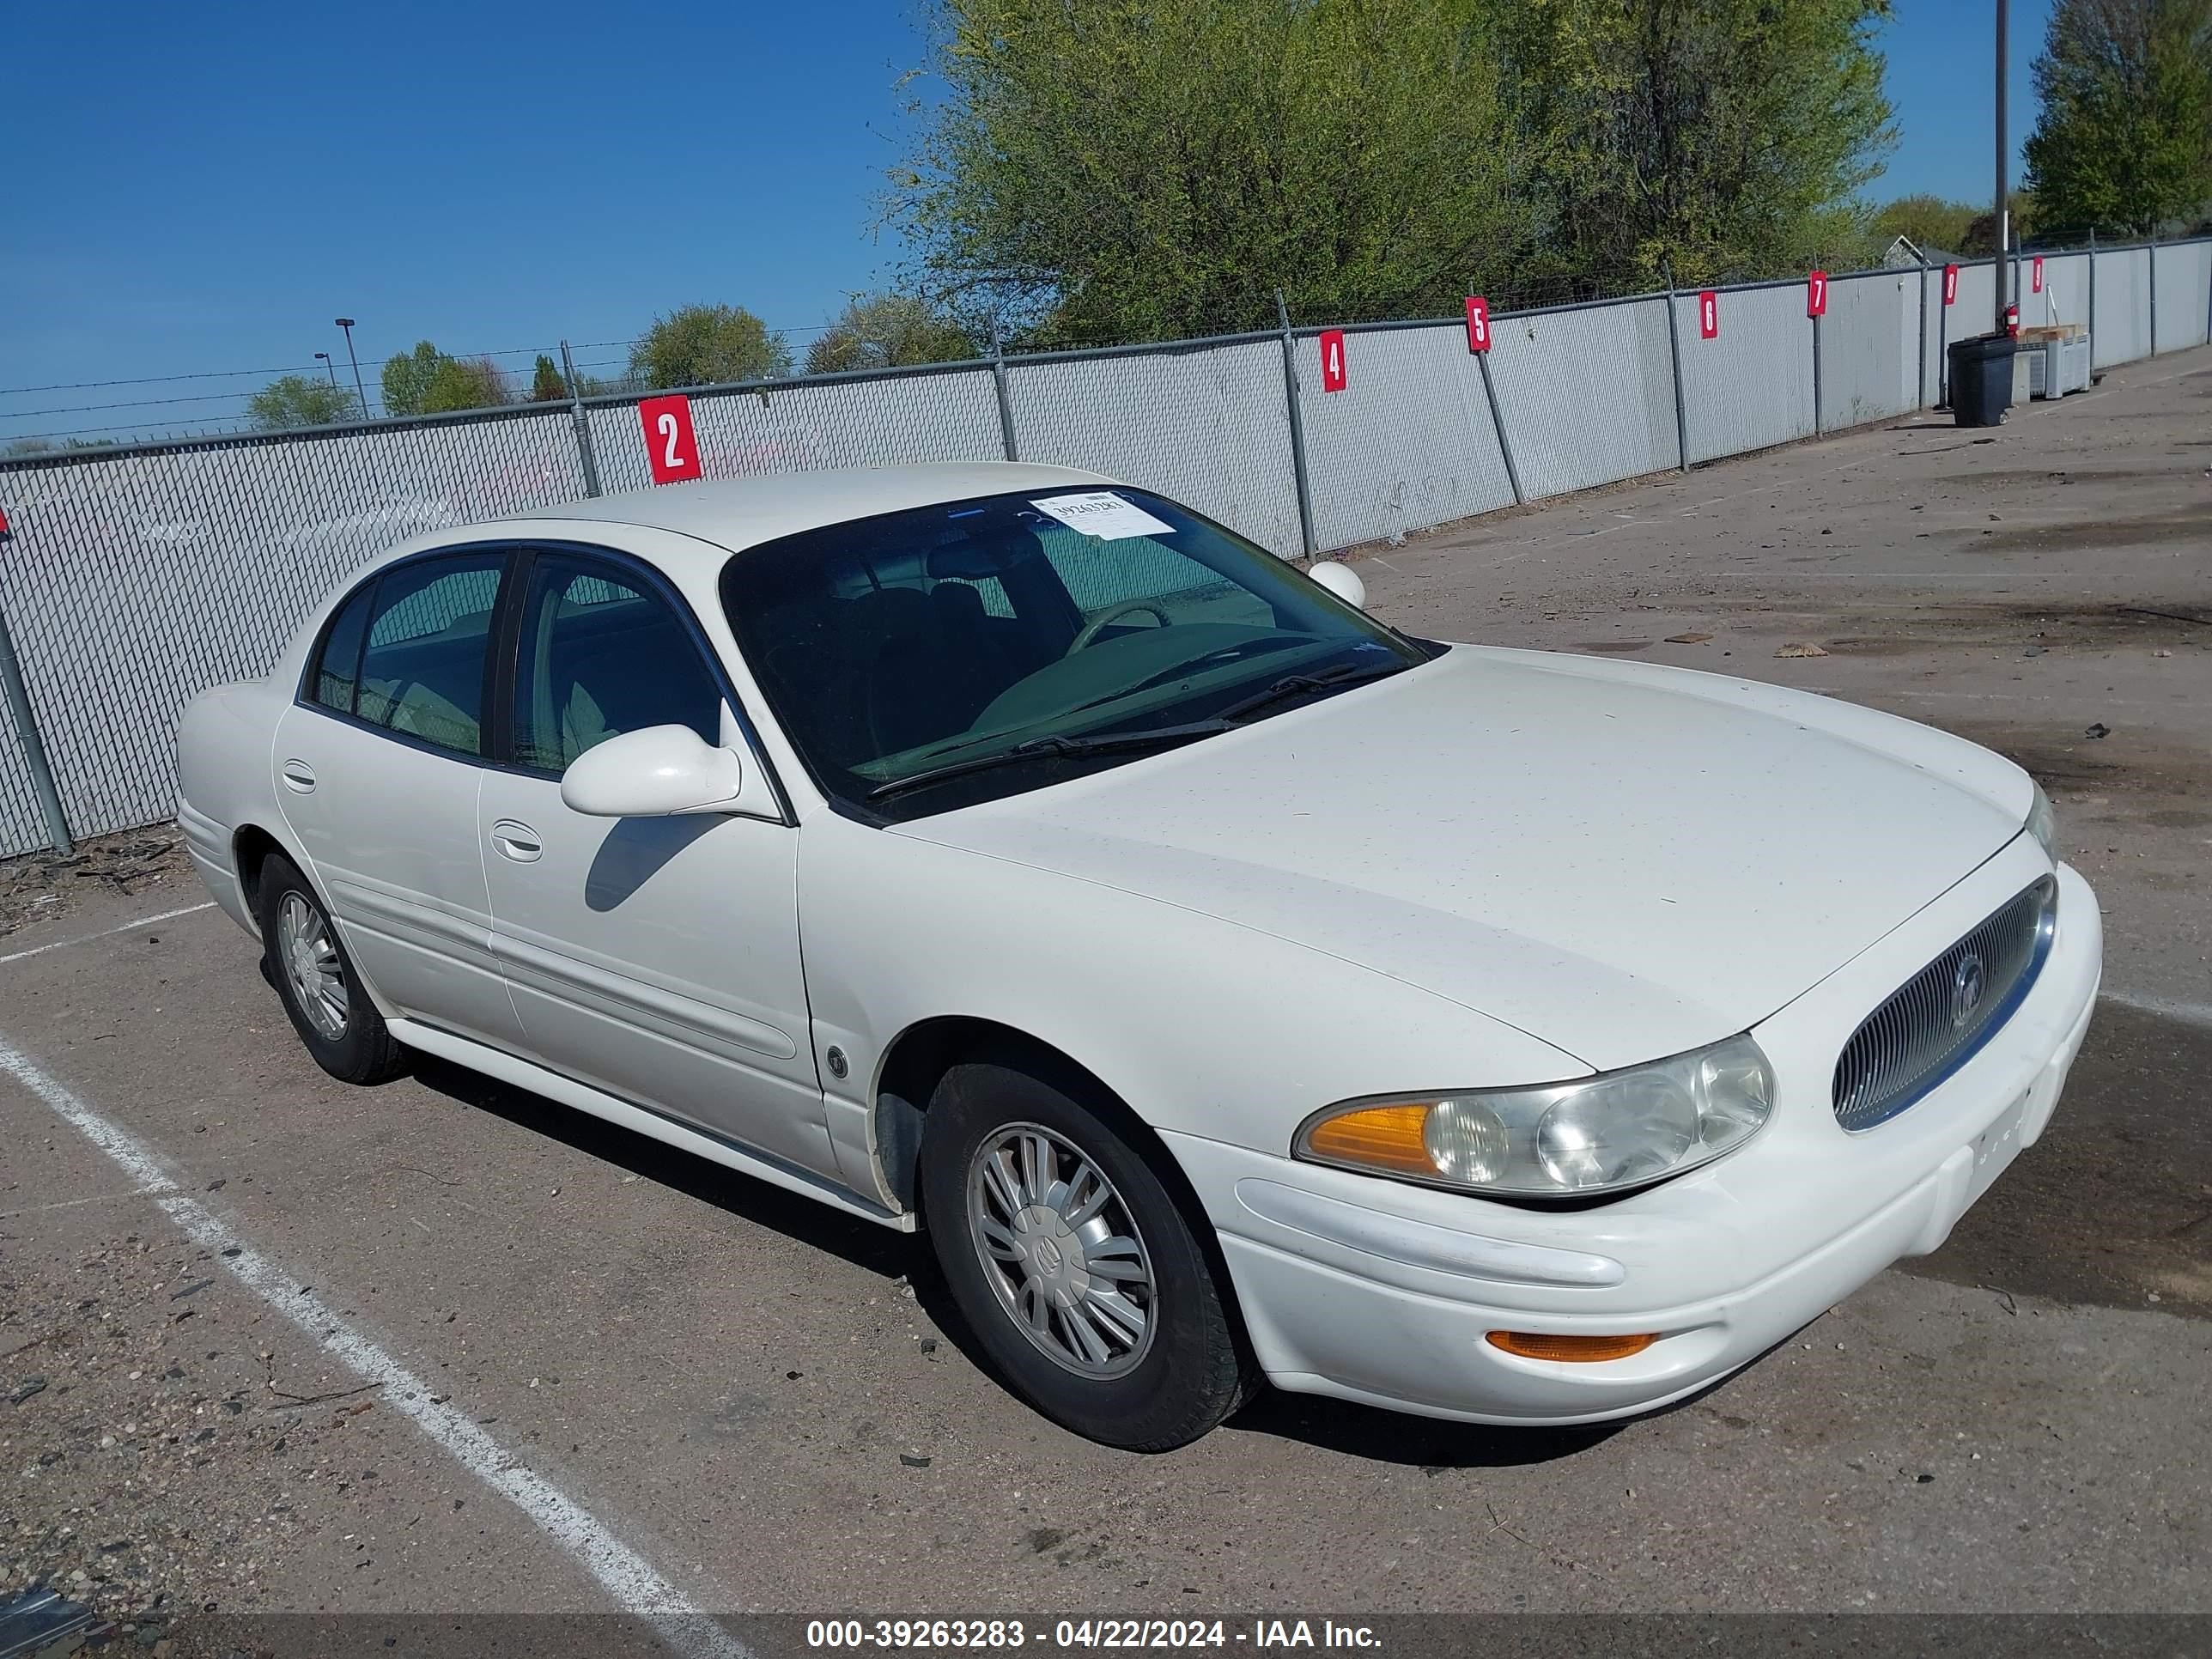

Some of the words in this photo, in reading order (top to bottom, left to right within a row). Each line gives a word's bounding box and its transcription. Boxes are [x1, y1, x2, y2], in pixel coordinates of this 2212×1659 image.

[1814, 279, 1822, 307] 7
[1948, 273, 1954, 299] 8
[1473, 307, 1485, 342] 5
[1705, 301, 1713, 331] 6
[1328, 343, 1340, 380] 4
[658, 413, 684, 468] 2
[1053, 501, 1124, 516] 39263283
